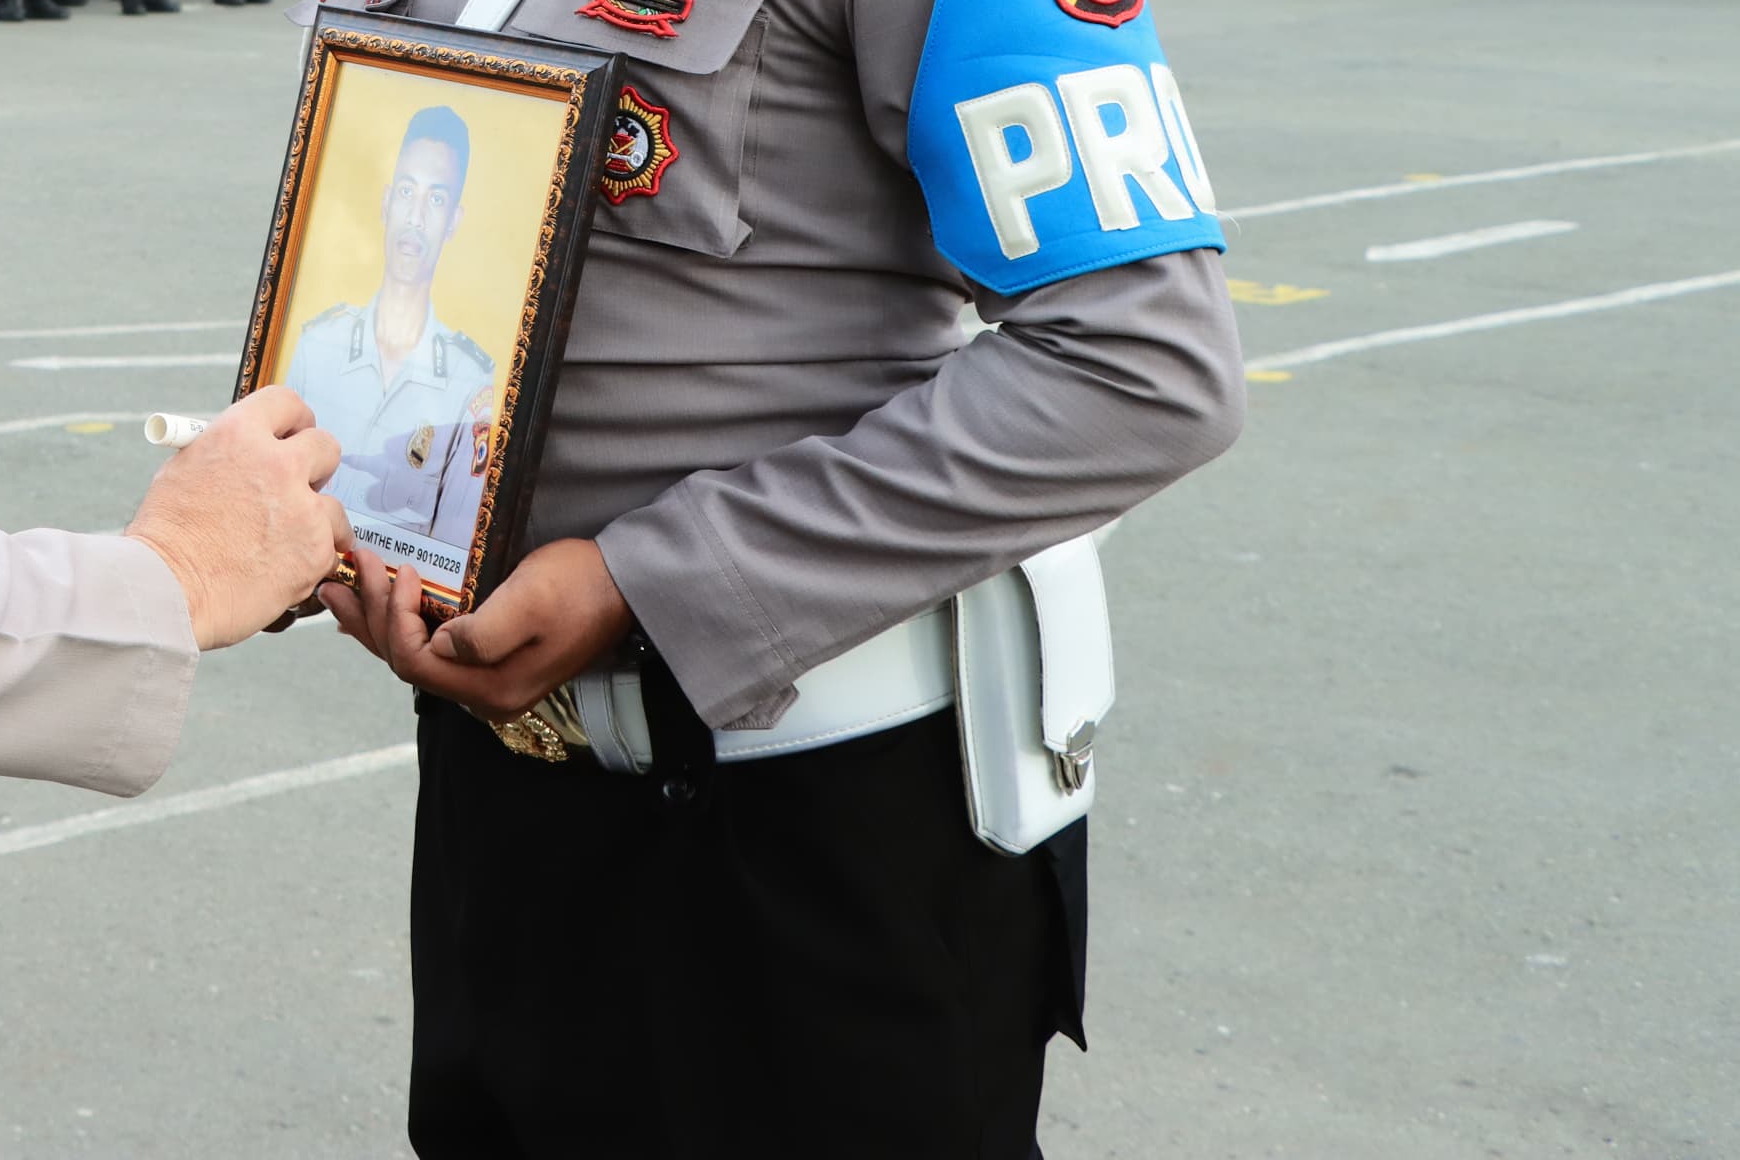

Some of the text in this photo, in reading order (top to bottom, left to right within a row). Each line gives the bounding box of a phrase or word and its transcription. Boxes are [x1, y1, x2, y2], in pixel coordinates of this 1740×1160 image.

[353, 525, 461, 575] RUMTHE NRP 90120228
